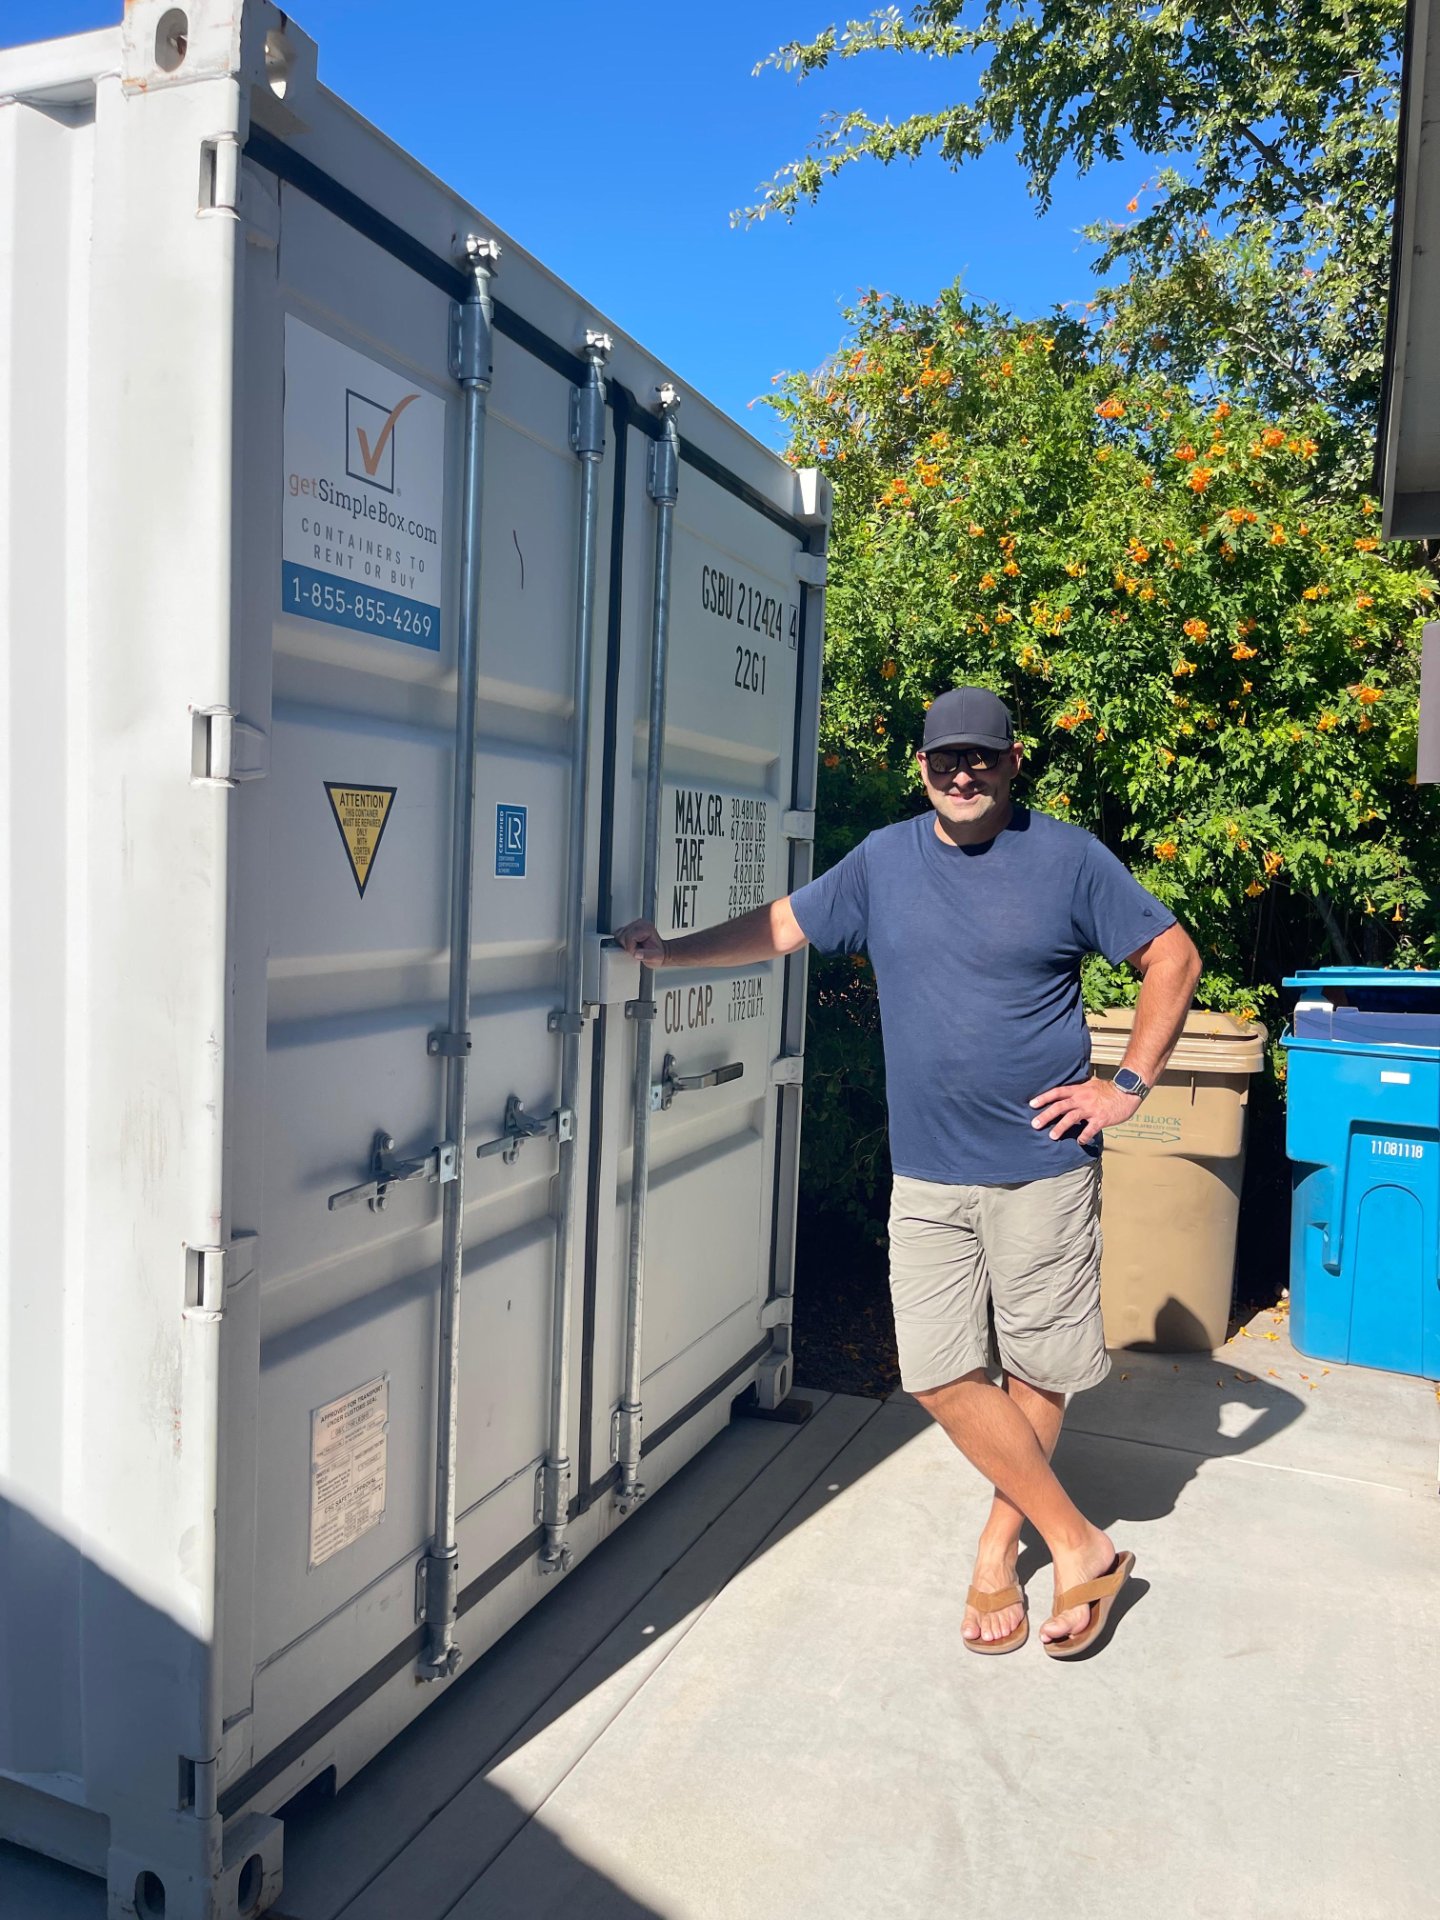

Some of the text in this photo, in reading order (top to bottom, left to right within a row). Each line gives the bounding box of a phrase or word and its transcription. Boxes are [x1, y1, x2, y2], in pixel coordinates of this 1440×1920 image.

[289, 472, 437, 544] getSimpleBox.com
[301, 518, 425, 573] CONTAINERS TO
[314, 544, 416, 590] RENT OR BUY
[292, 577, 433, 638] 1-855-855-4269
[702, 564, 797, 648] GSBU 212424 4
[735, 645, 766, 695] 22G1
[340, 793, 384, 809] ATTENTION
[731, 798, 754, 820] 30.480
[755, 801, 767, 821] KGS
[345, 808, 378, 818] THIS CONTAINER
[355, 818, 361, 827] BE
[361, 819, 381, 828] REPAIRED
[356, 828, 368, 837] ONLY
[356, 838, 368, 846] WITH
[731, 821, 766, 842] 67.200 LBS
[353, 847, 371, 855] CORTEN
[355, 856, 368, 865] STEEL
[675, 837, 766, 882] TARE 2.185 KGS
[733, 863, 765, 884] 4.820 LBS
[672, 885, 764, 929] NET 28.295 KGS
[664, 988, 684, 1034] CU.
[687, 984, 715, 1029] CAP.
[732, 981, 747, 1001] 33.2
[1144, 1114, 1182, 1126] BLOCK
[1371, 1140, 1424, 1159] 11081118
[347, 1399, 357, 1409] FOR
[366, 1396, 378, 1406] SEAL
[335, 1491, 353, 1507] SAFETY
[353, 1477, 377, 1496] APPROVAL
